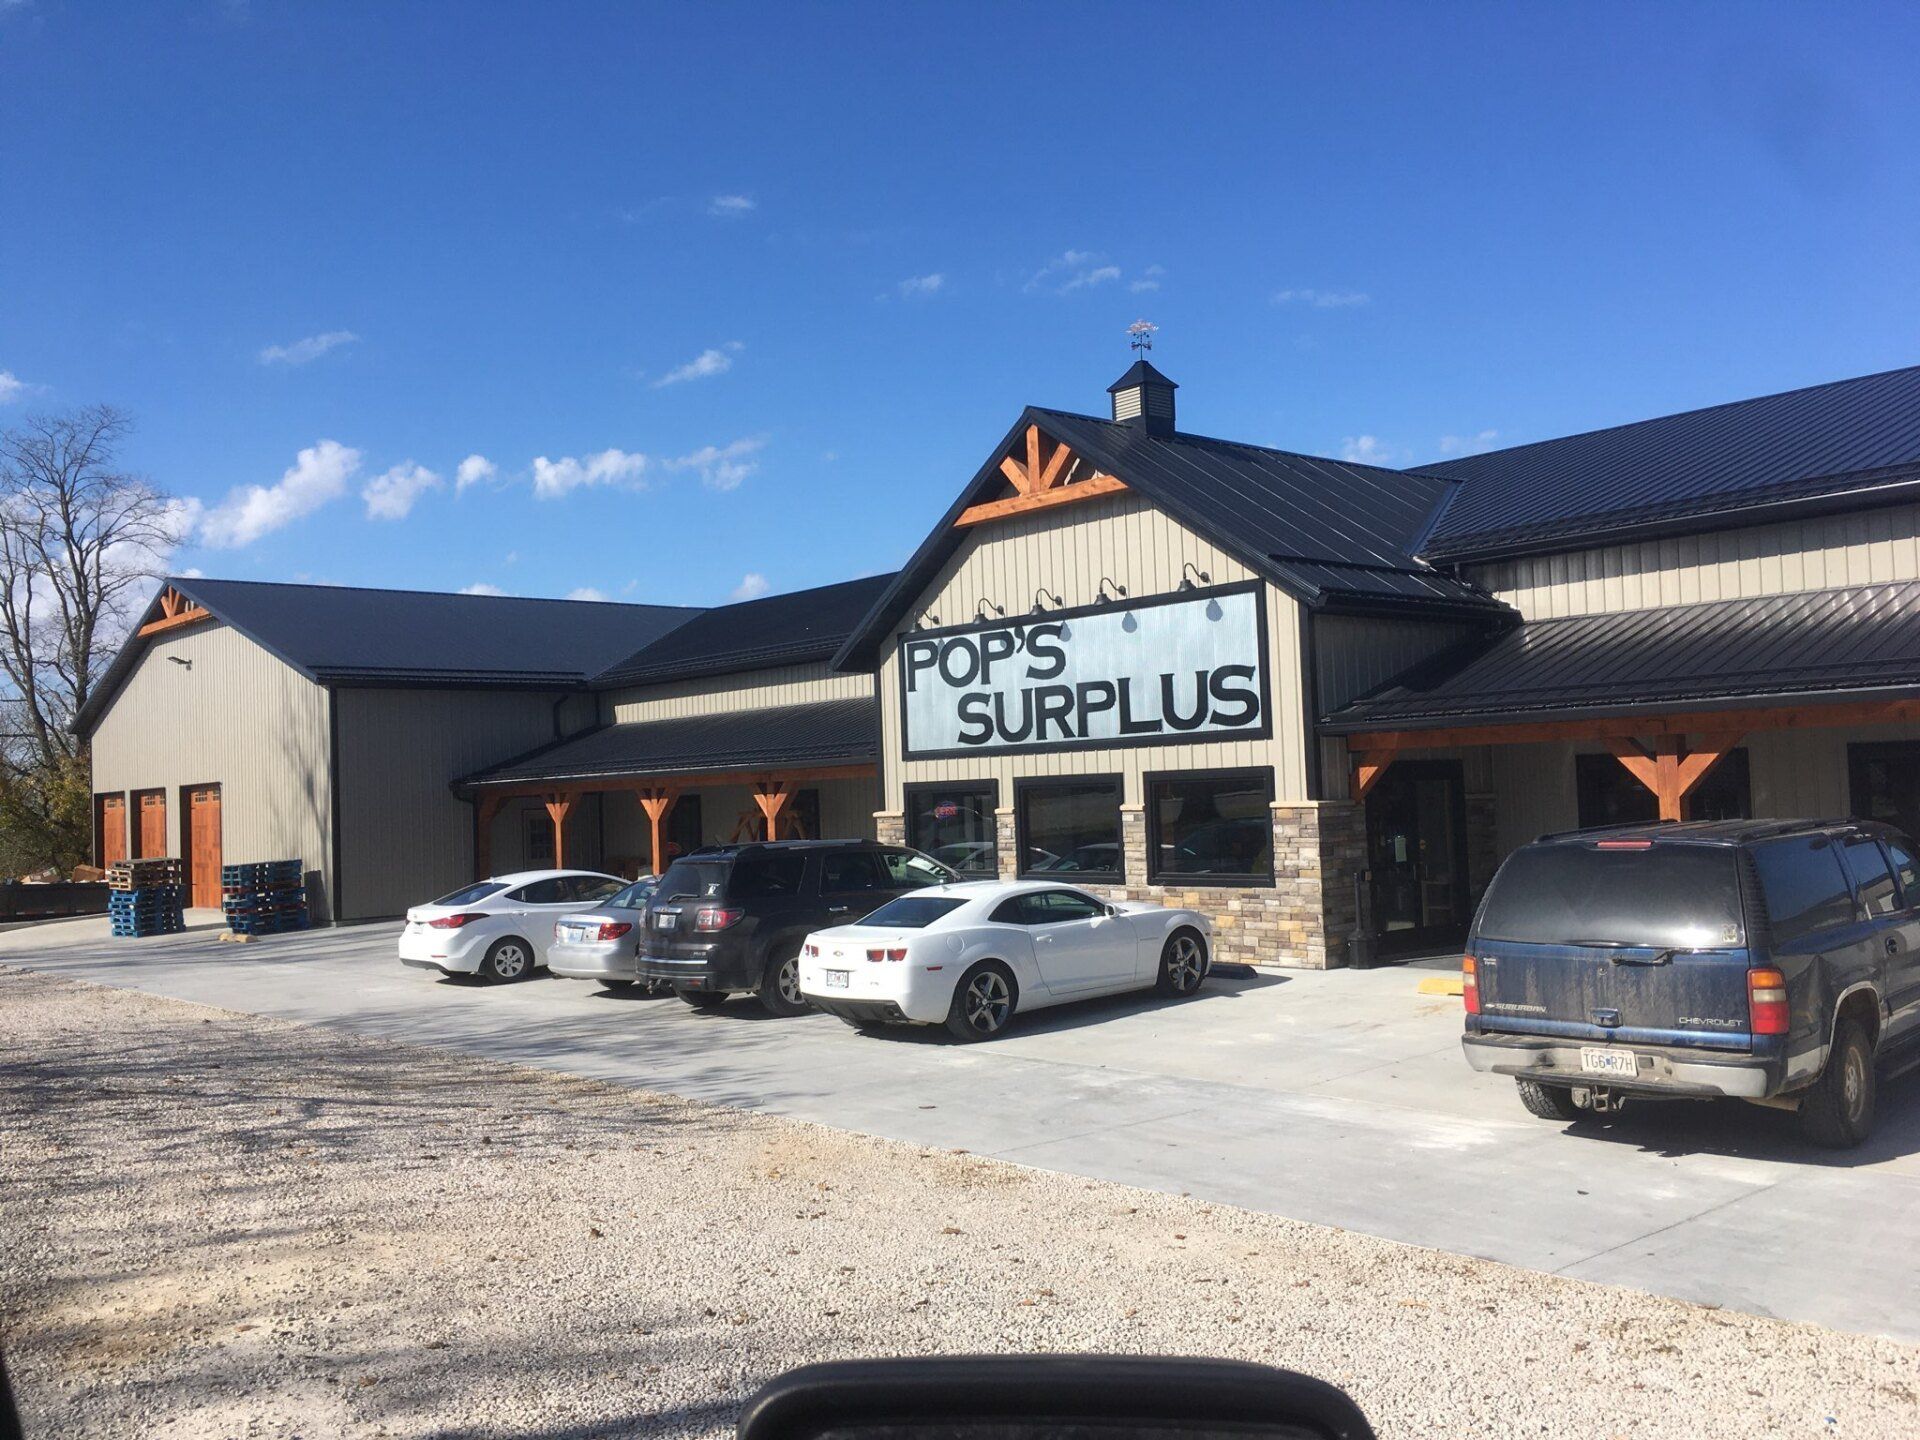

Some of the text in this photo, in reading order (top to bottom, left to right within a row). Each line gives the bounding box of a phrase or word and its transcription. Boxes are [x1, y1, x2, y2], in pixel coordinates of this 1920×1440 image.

[906, 623, 1067, 693] POP'S
[957, 664, 1260, 746] SURPLUS
[1495, 1003, 1548, 1014] SUBURBAN
[1678, 1016, 1744, 1028] CHEVROLET
